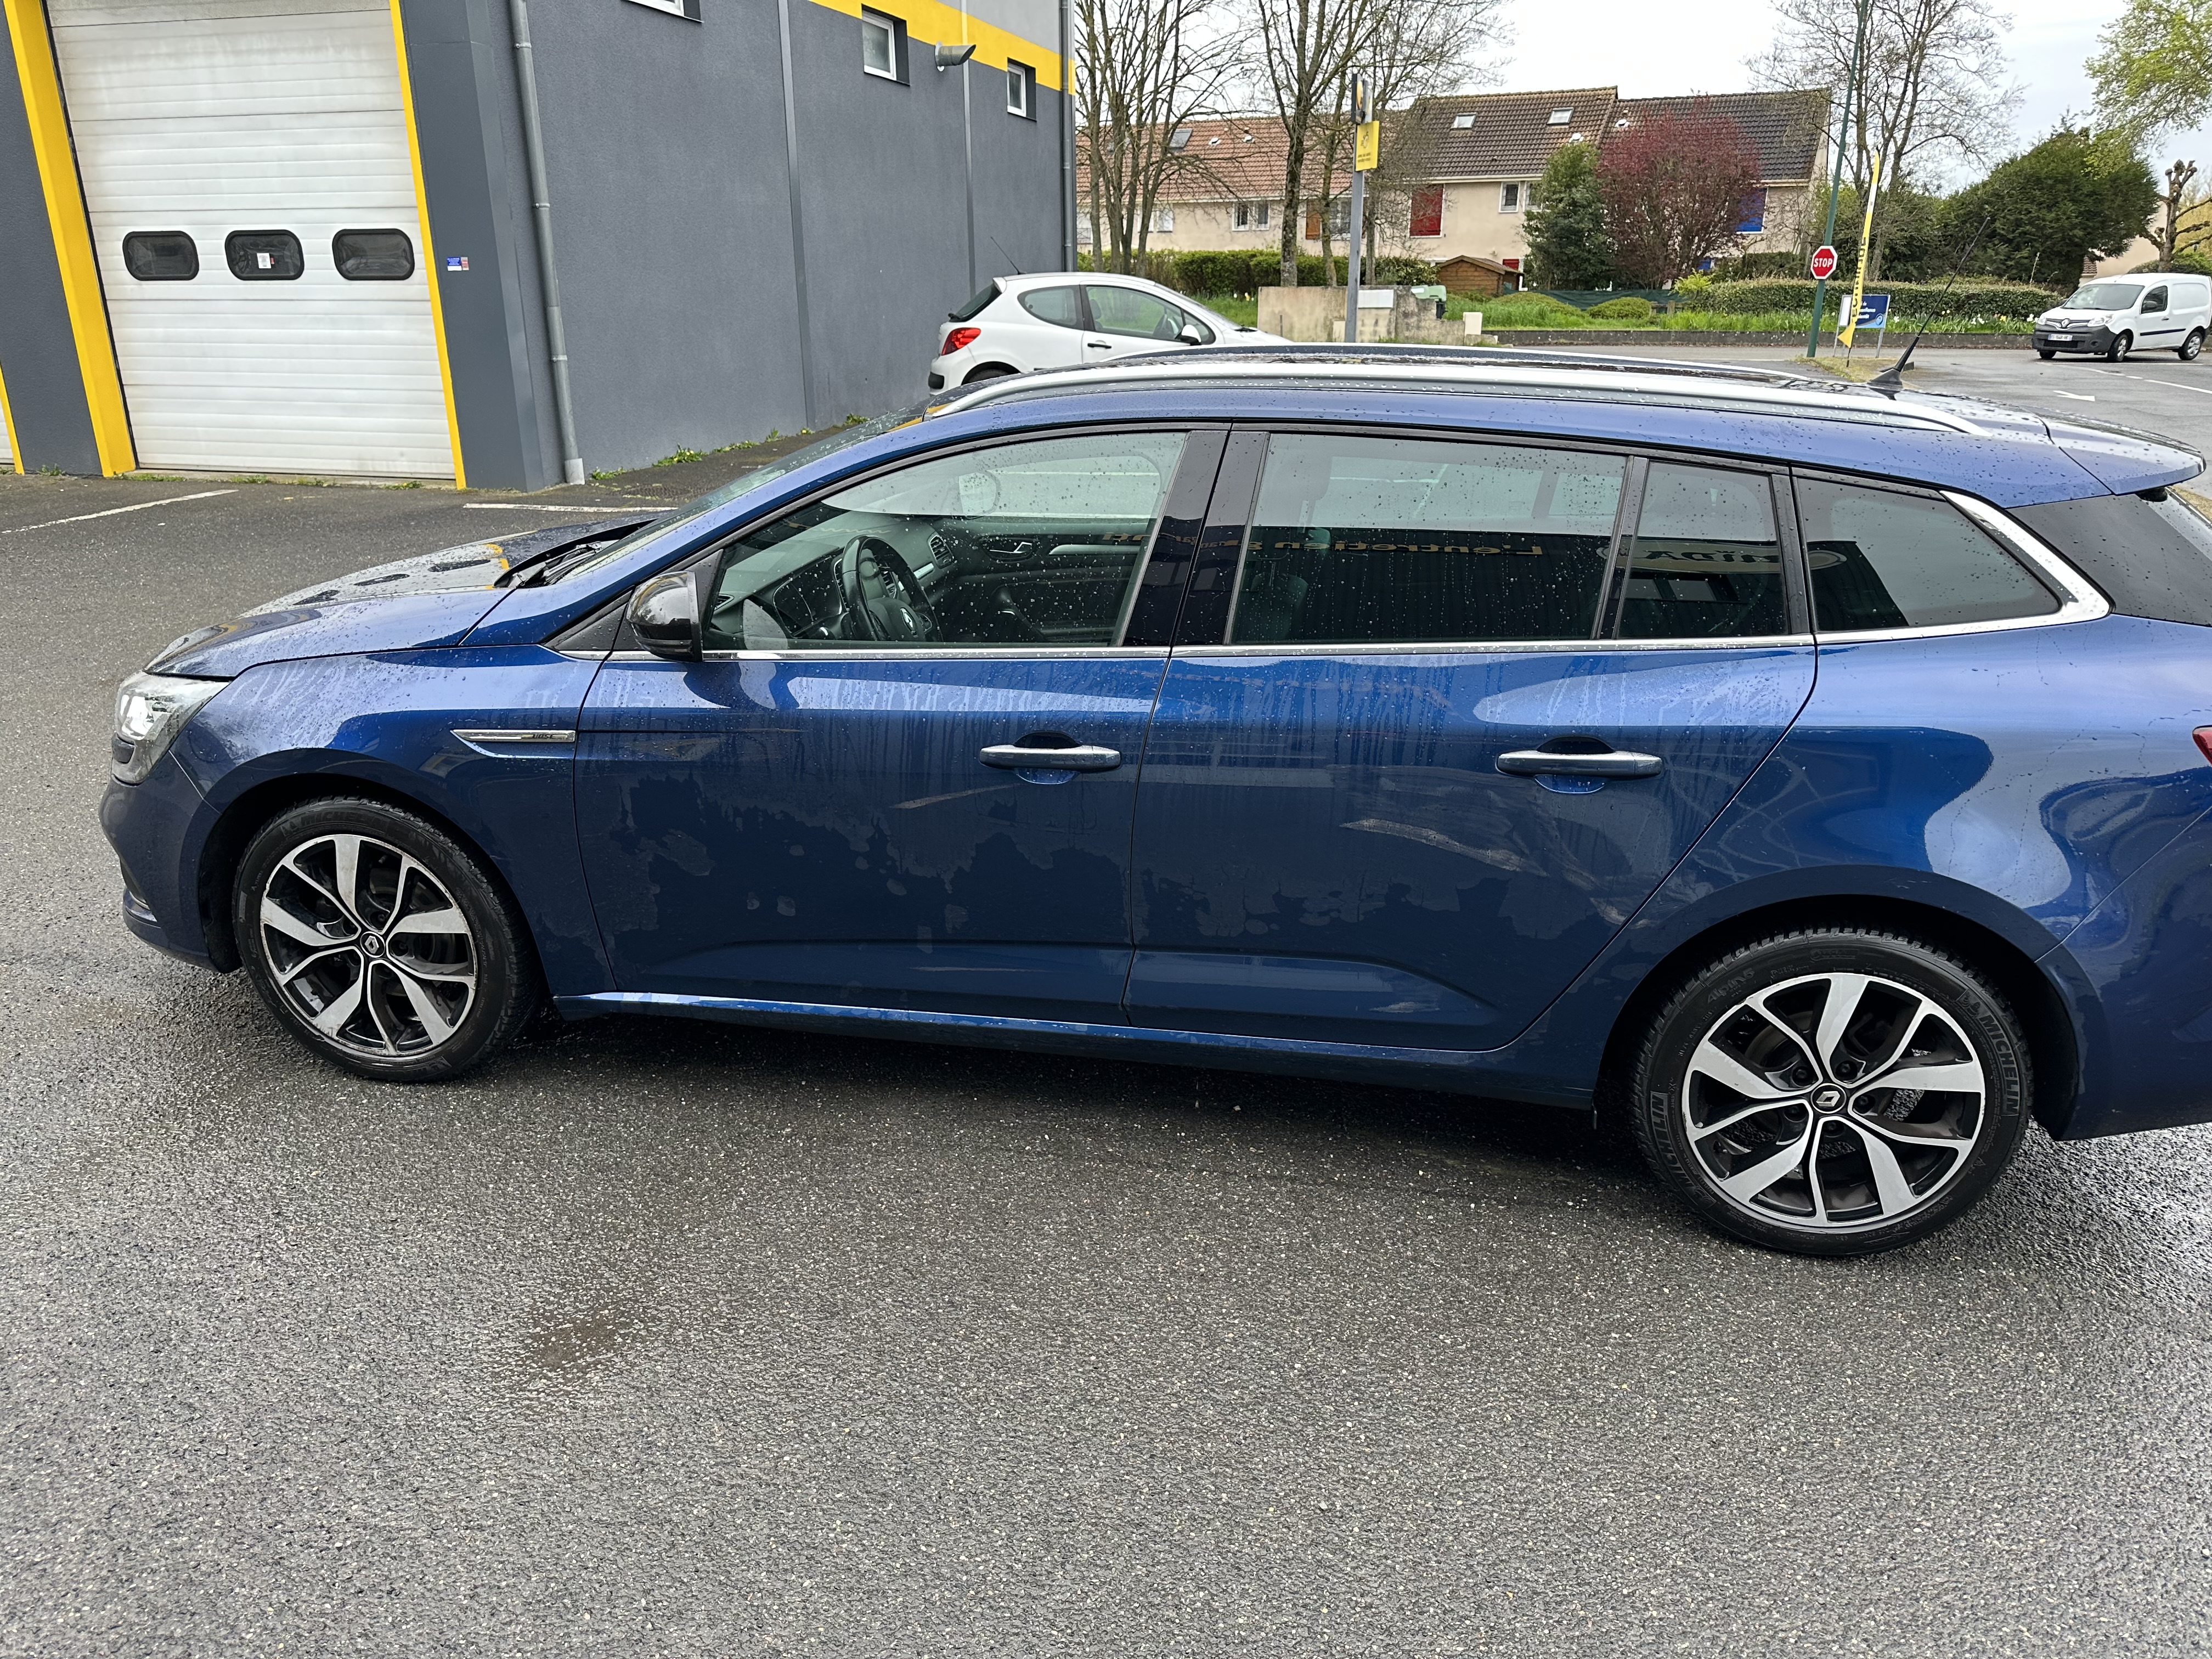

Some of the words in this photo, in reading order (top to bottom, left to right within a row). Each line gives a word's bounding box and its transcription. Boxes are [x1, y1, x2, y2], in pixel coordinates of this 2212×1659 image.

[1813, 258, 1833, 268] STOP
[1979, 1014, 2019, 1115] MICHELIN
[1651, 1094, 1695, 1188] MICHELIN
